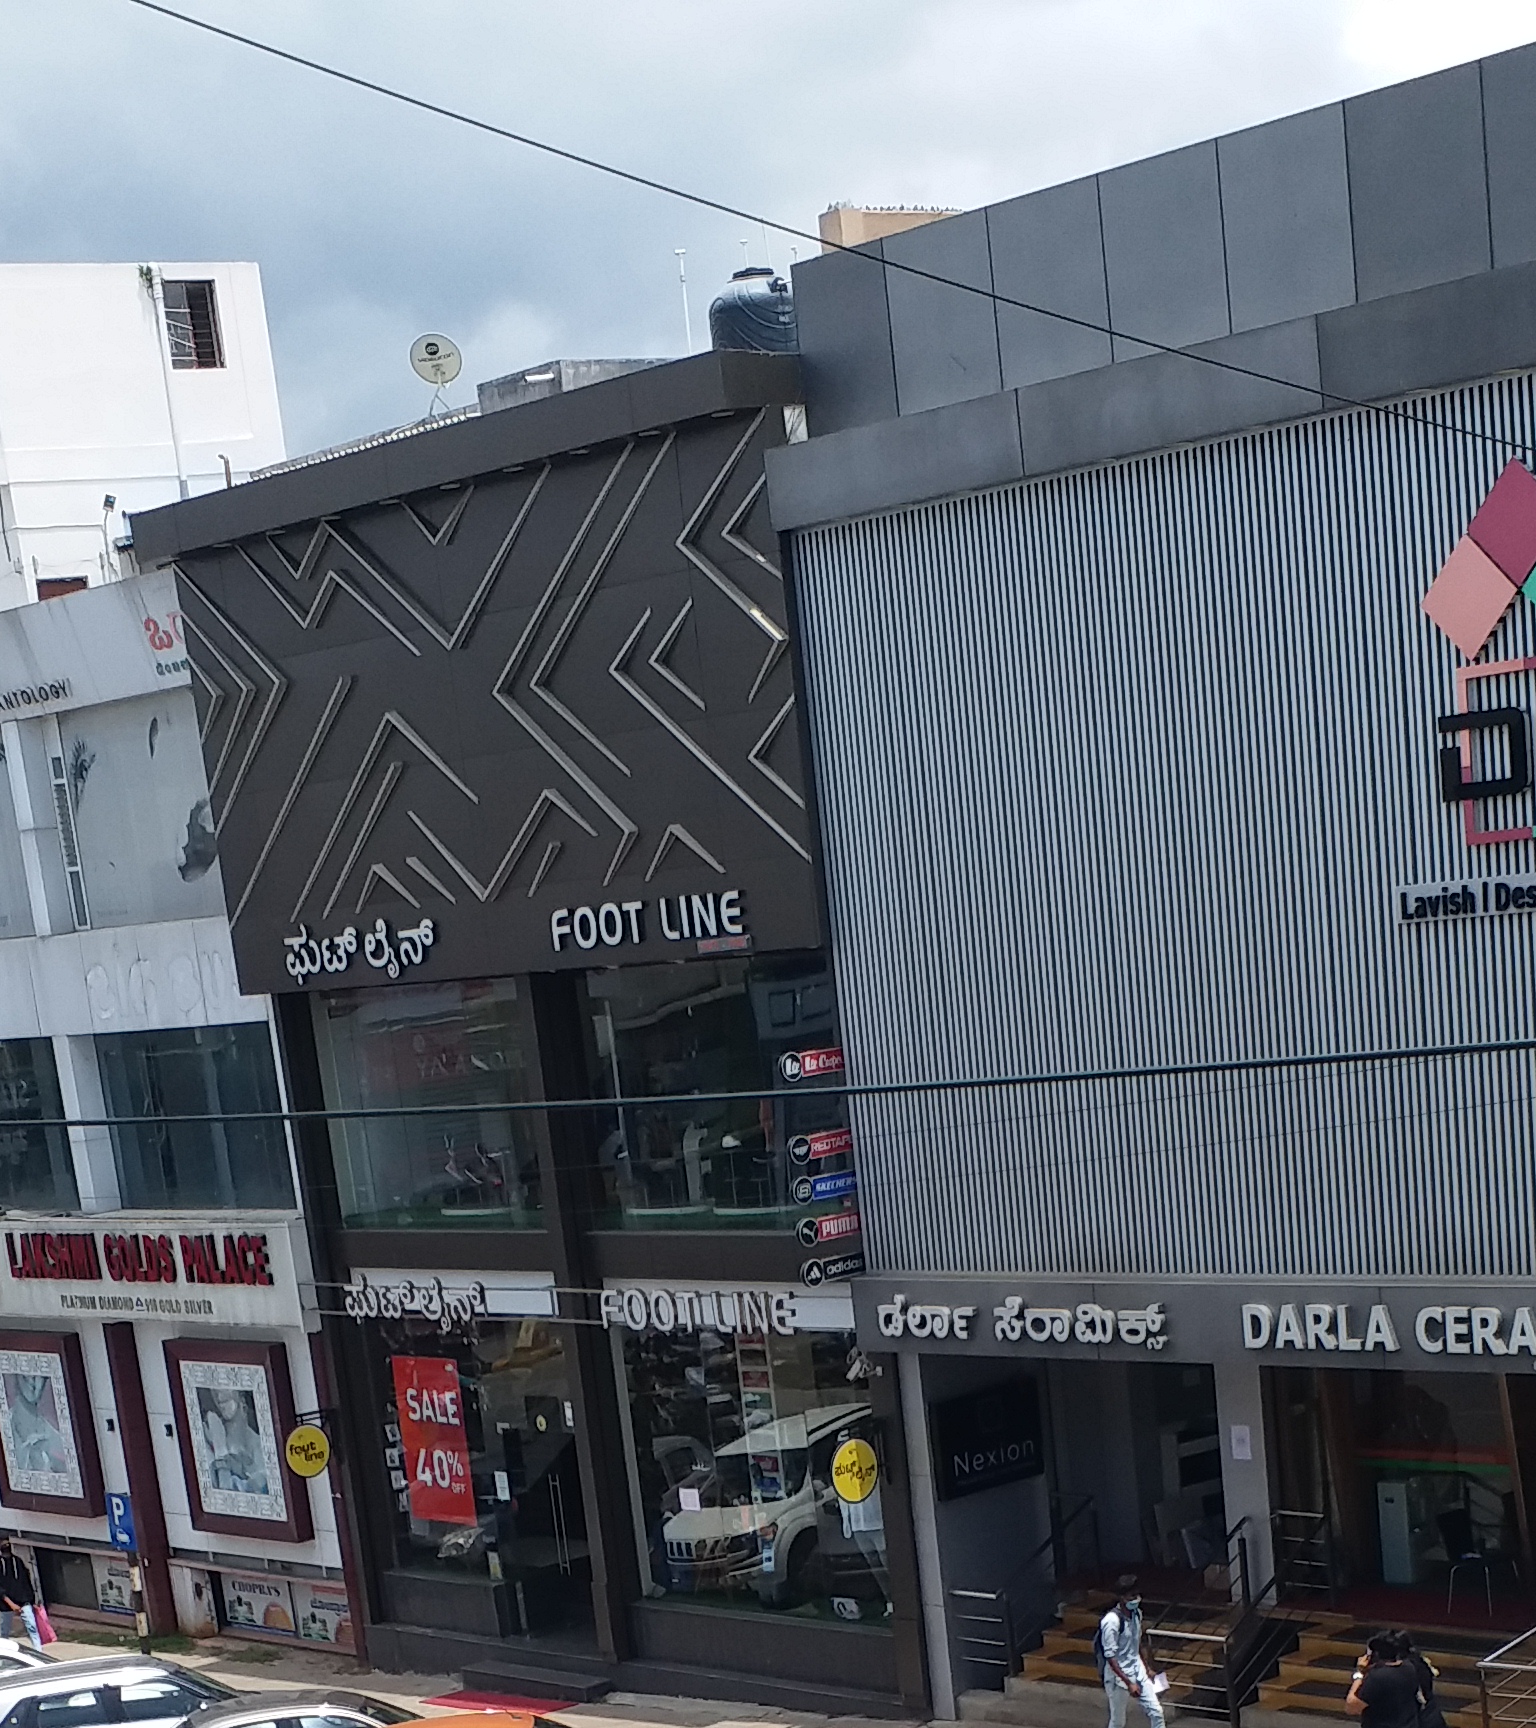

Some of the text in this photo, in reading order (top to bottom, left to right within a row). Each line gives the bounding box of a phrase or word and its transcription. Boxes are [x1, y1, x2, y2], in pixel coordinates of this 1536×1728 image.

[550, 890, 744, 952] FOOT LINE
[1399, 885, 1477, 920] Lavish
[822, 1214, 859, 1237] PUMA
[5, 1232, 275, 1286] LAKSHMI GOLDS PALACE
[61, 1294, 97, 1310] PLATINUM
[99, 1295, 134, 1312] DIAMOND
[159, 1298, 182, 1314] GOLD
[184, 1299, 215, 1315] SILVER
[600, 1288, 798, 1335] FOOT LINE
[1241, 1304, 1401, 1352] DARLA
[405, 1386, 461, 1427] SALE
[304, 1449, 325, 1463] line
[416, 1448, 465, 1489] 40%
[953, 1439, 1035, 1477] Nexion
[451, 1481, 467, 1495] OFF
[110, 1497, 125, 1526] P
